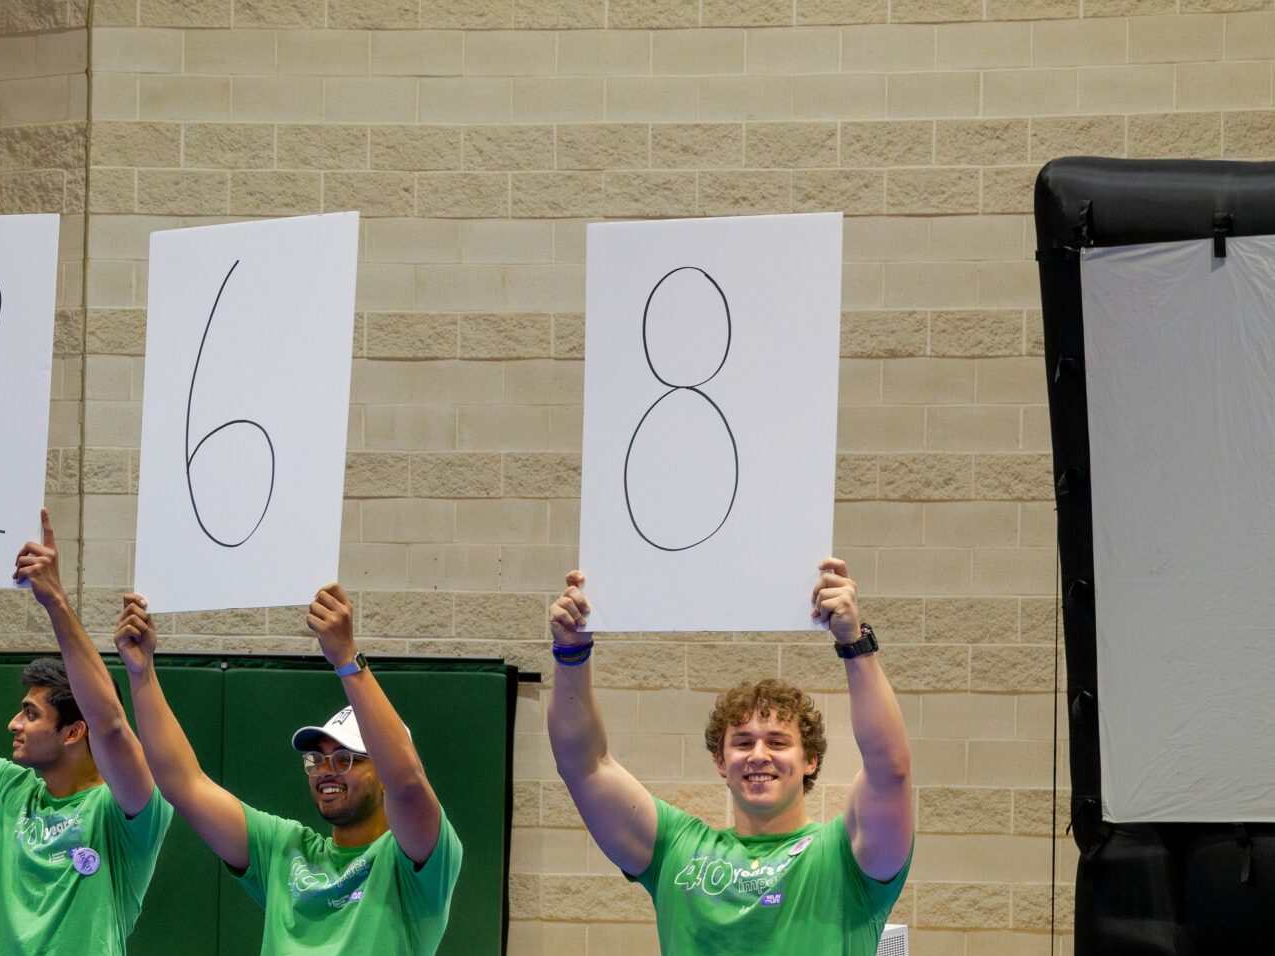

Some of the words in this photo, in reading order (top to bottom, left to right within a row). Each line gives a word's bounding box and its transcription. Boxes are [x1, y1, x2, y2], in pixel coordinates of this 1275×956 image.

[185, 260, 275, 548] 6
[624, 267, 738, 551] 8
[674, 856, 733, 895] 40
[733, 863, 774, 883] years
